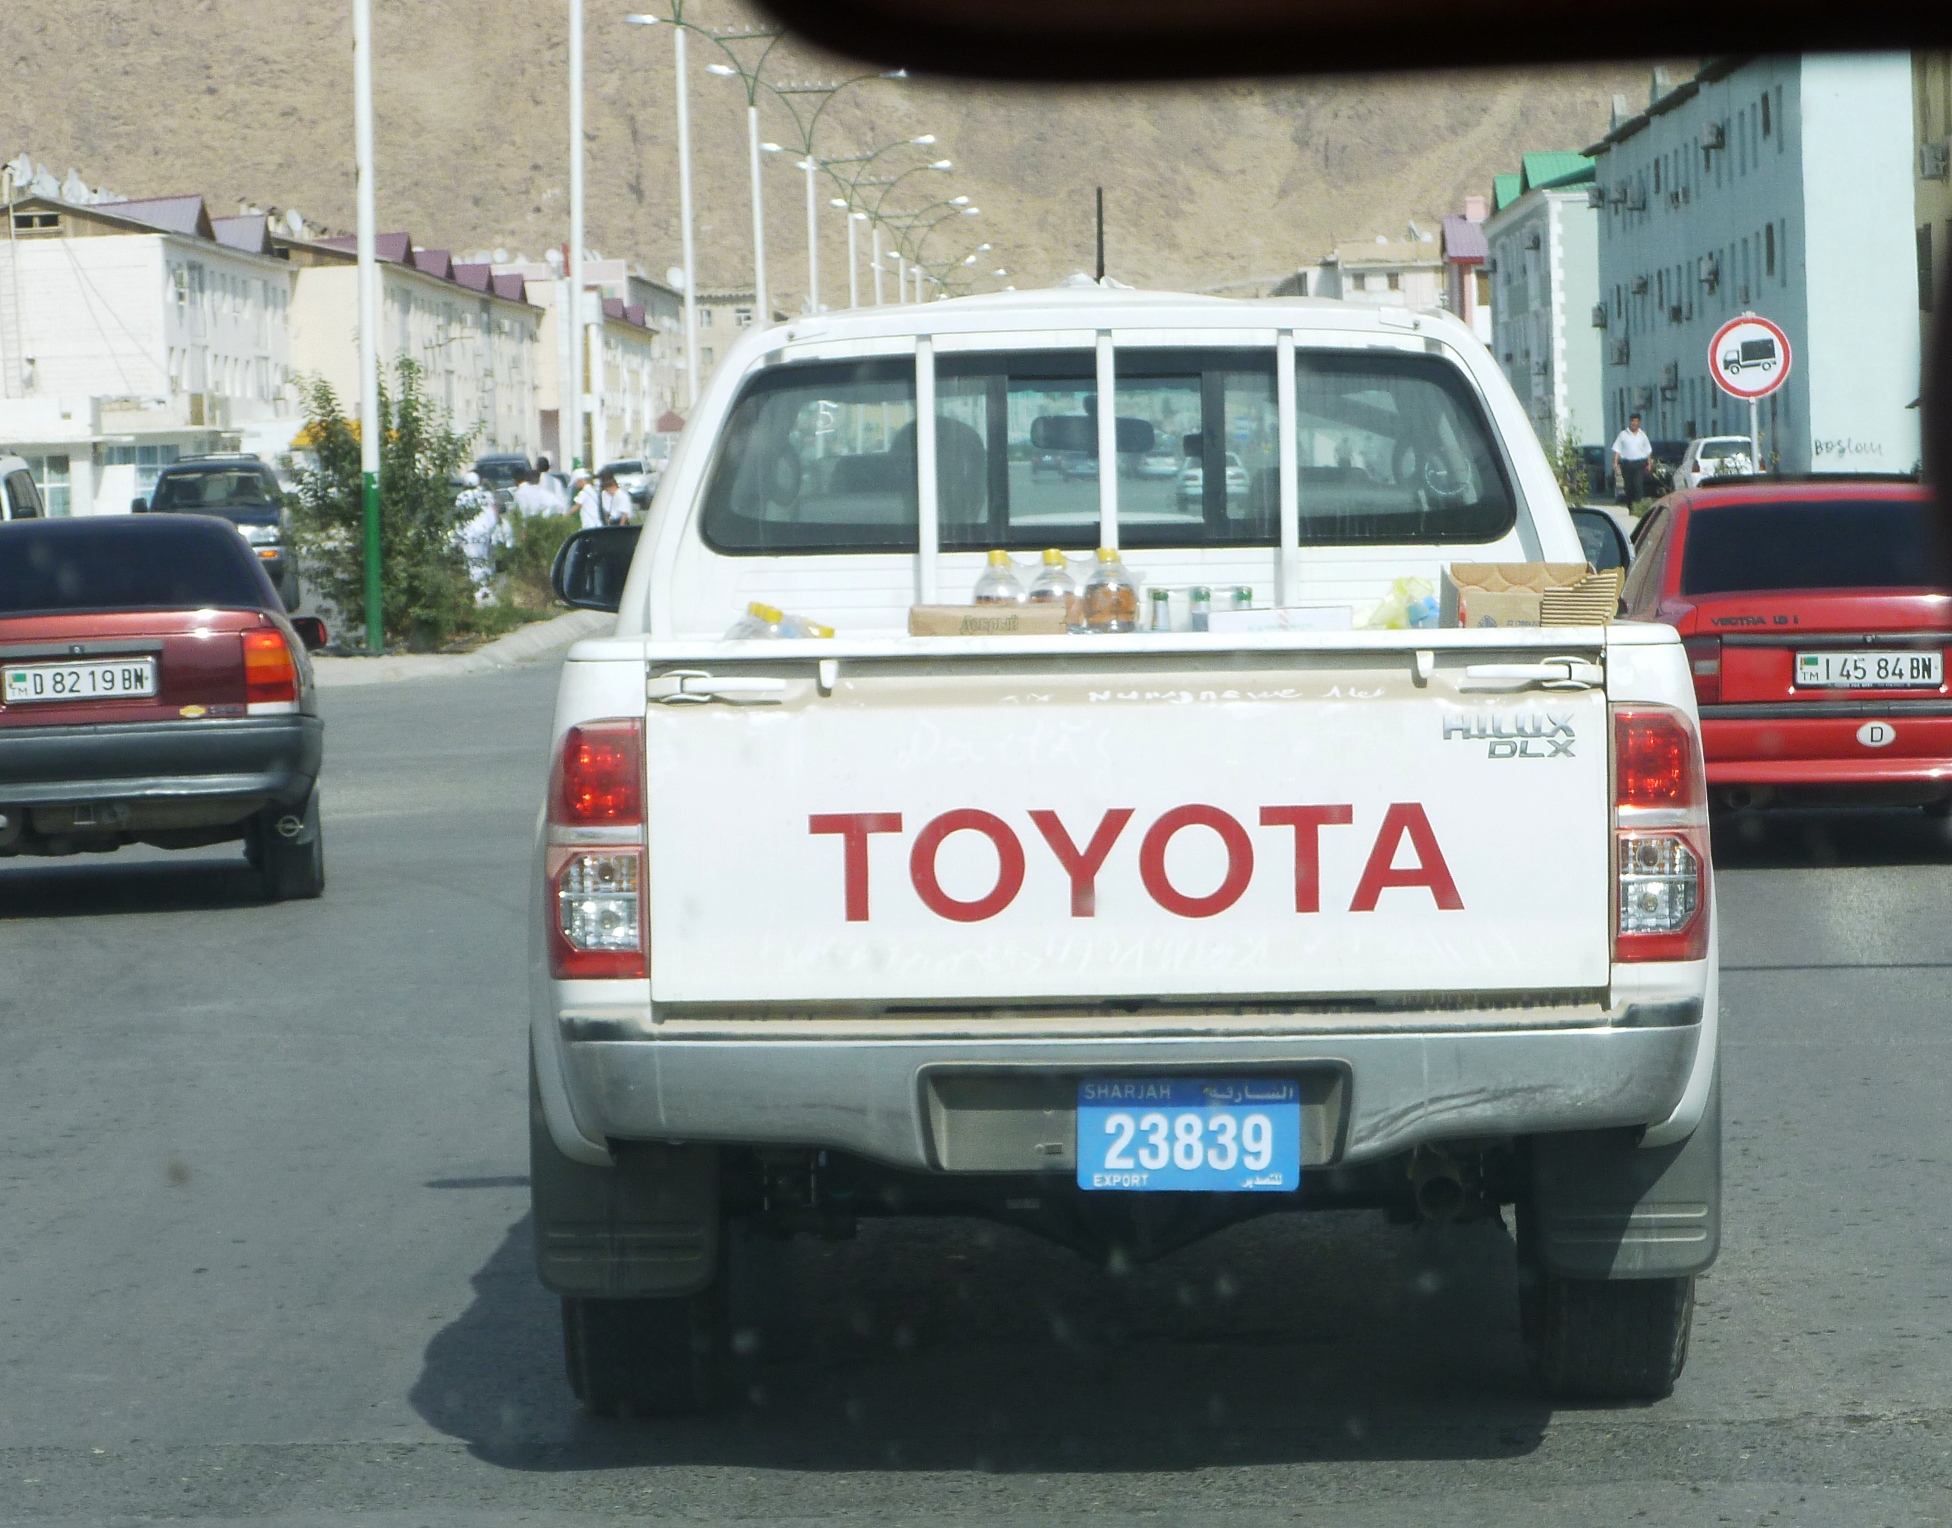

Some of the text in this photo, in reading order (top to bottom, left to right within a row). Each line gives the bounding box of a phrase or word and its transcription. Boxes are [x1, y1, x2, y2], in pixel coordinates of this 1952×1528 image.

[1443, 713, 1575, 740] HILUX
[1870, 726, 1884, 743] D
[1488, 739, 1576, 759] DLX
[808, 802, 1465, 923] TOYOTA
[1084, 1084, 1171, 1100] SHARJAH
[1104, 1112, 1273, 1171] 23839
[1093, 1174, 1149, 1187] EXPORT
